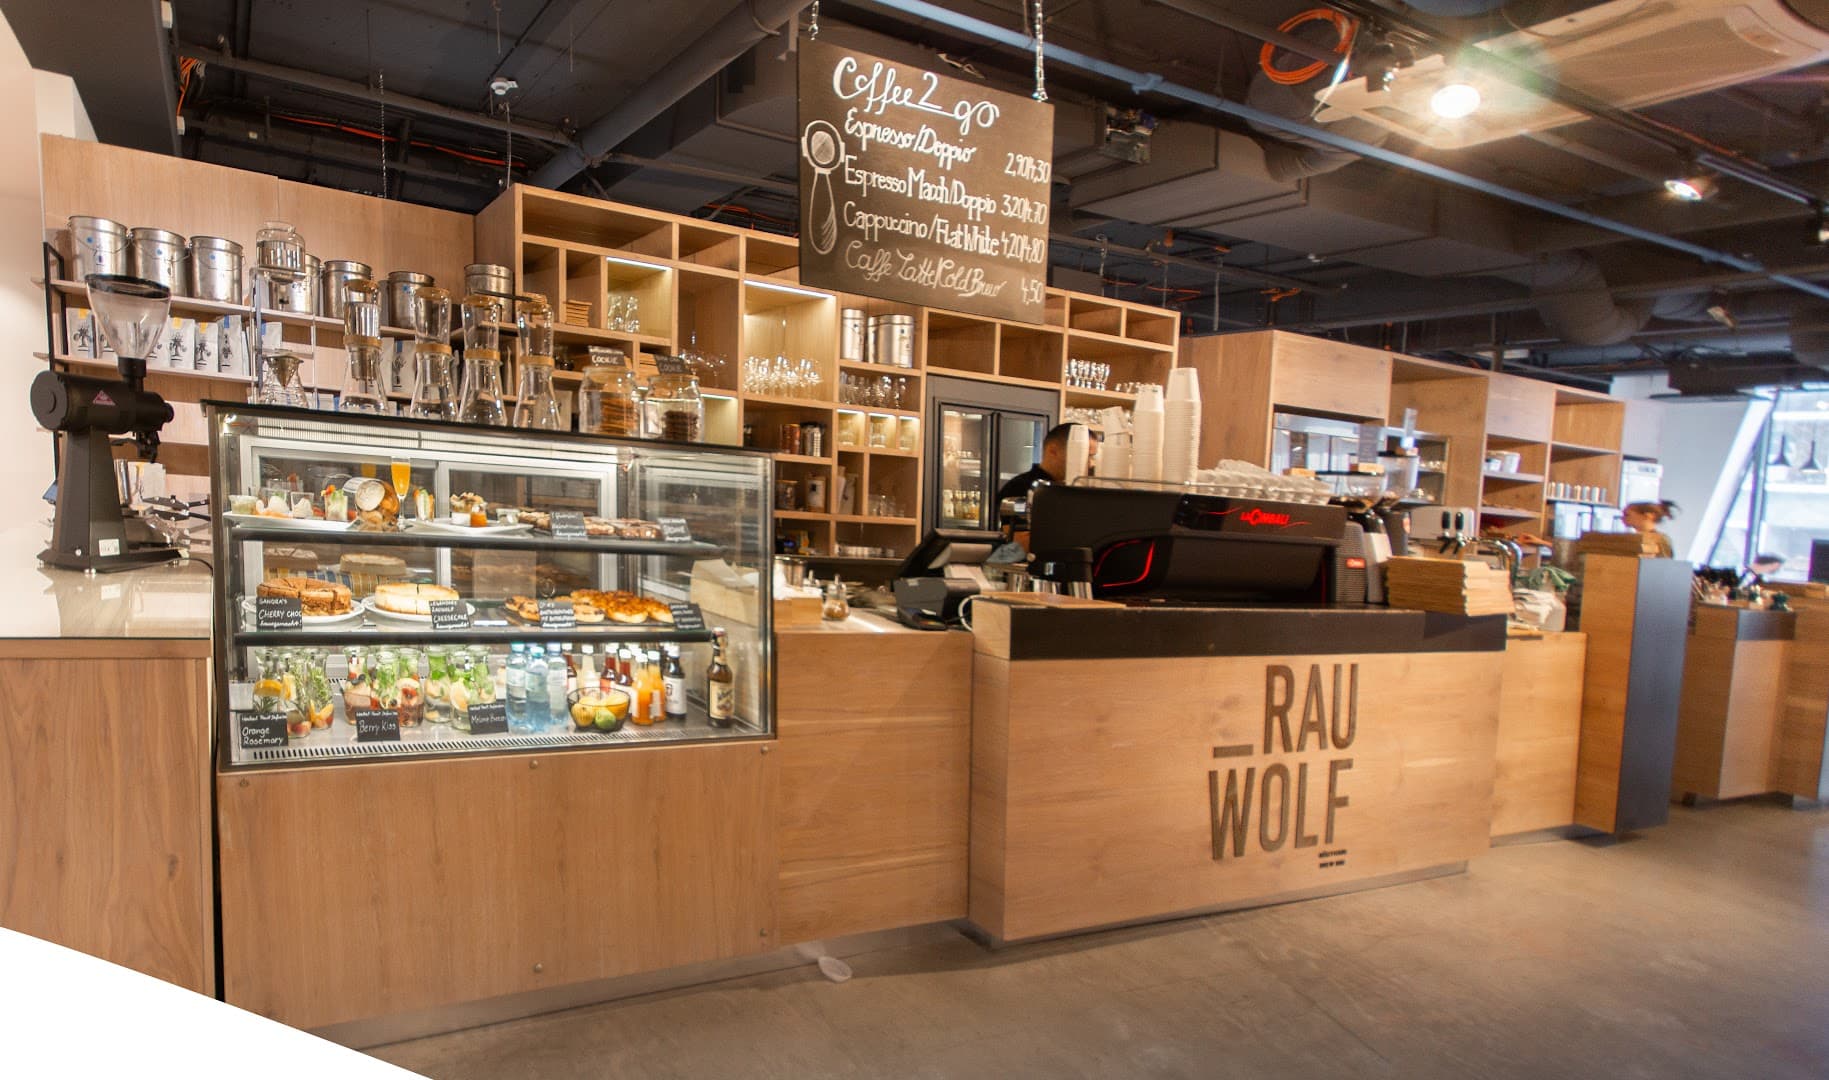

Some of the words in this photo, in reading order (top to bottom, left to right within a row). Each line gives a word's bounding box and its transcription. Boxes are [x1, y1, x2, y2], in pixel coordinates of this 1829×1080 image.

[833, 56, 914, 115] Coffee
[919, 71, 943, 110] 2
[954, 100, 1000, 136] go
[844, 154, 907, 198] Espresso
[258, 610, 285, 620] CHERRY
[1263, 663, 1359, 754] RAU
[242, 726, 270, 738] Orange
[243, 736, 284, 746] Rosemary
[359, 719, 380, 735] Berry
[381, 719, 396, 731] Kiss
[1208, 758, 1354, 861] WOLF
